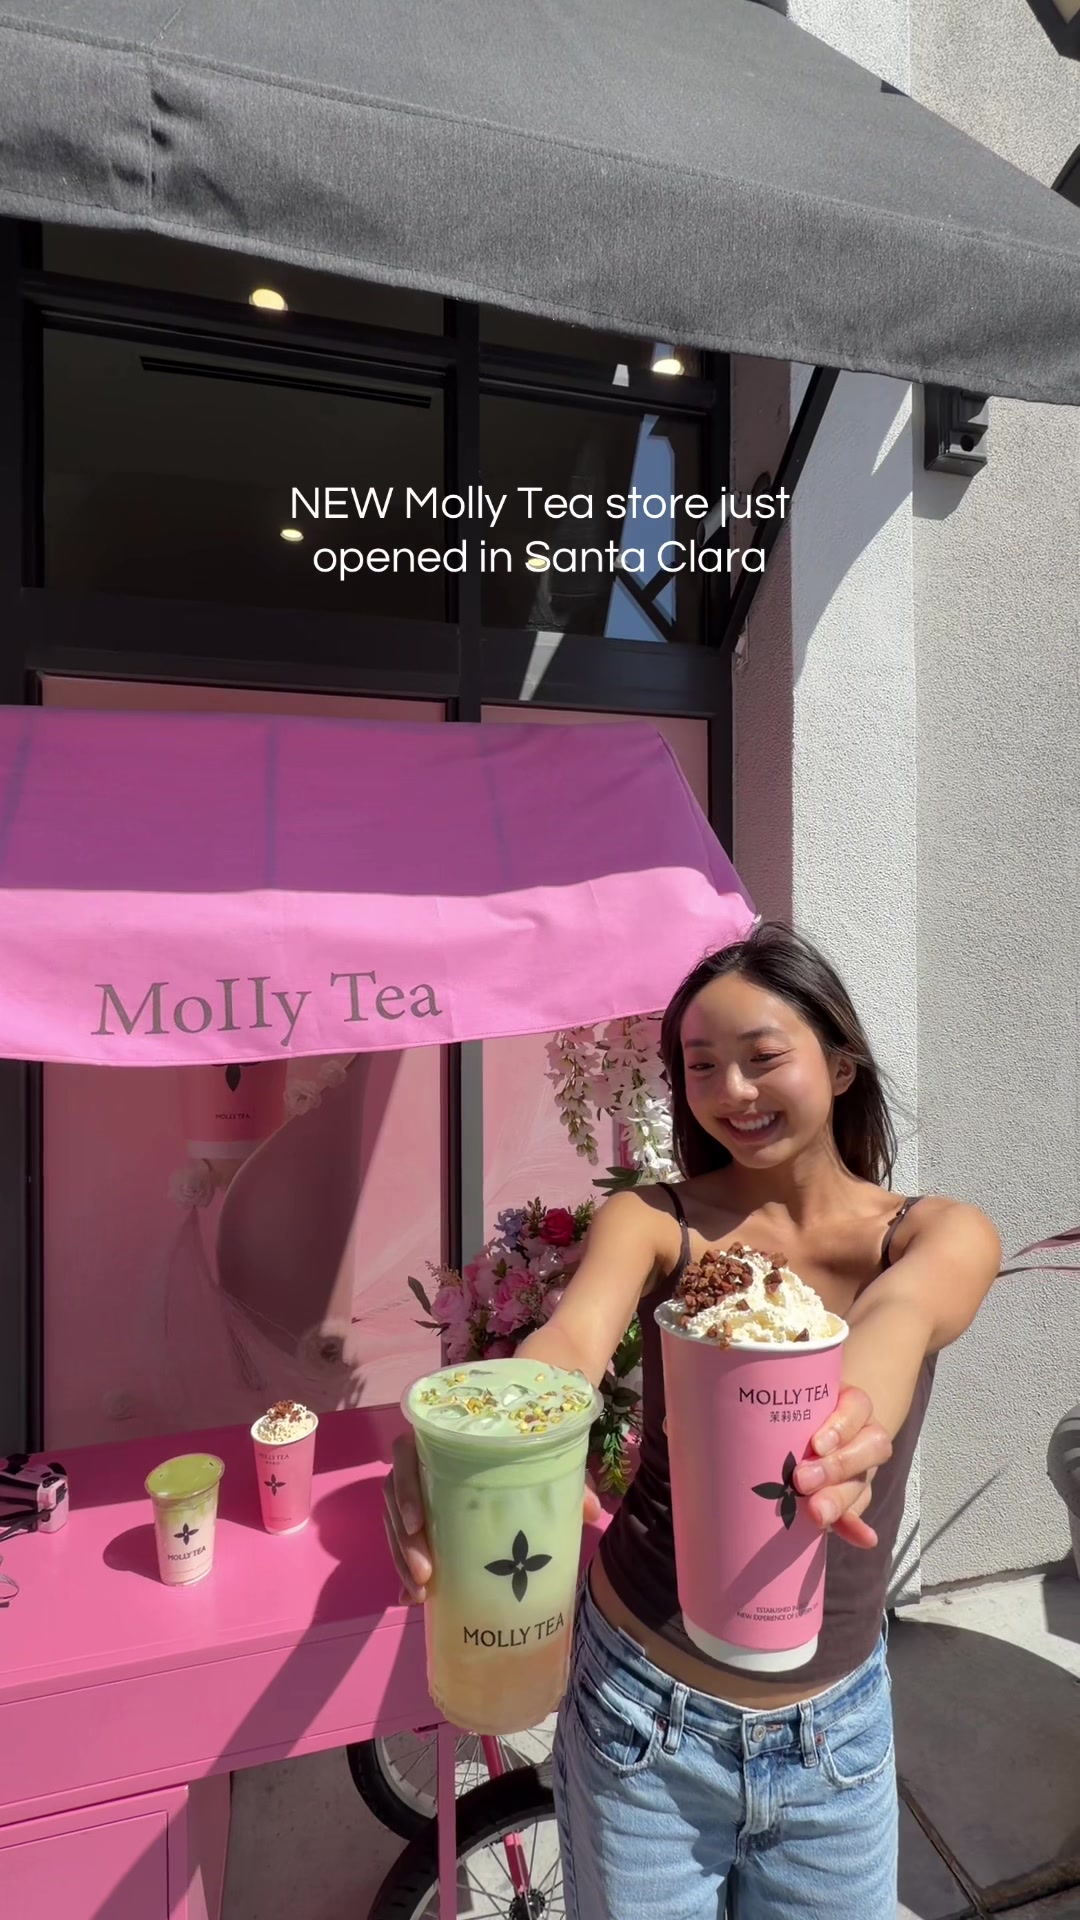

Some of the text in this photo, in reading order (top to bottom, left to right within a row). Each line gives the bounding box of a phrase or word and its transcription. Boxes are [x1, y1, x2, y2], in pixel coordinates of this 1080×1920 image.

[330, 970, 443, 1023] Tea
[739, 1383, 829, 1406] MOLLY TEA
[769, 1409, 811, 1423] 茉莉奶白
[167, 1545, 206, 1561] MOLLY TEA
[736, 1611, 752, 1620] NEW
[756, 1606, 791, 1614] ESTABLISHED
[463, 1612, 564, 1648] MOLLY TEA
